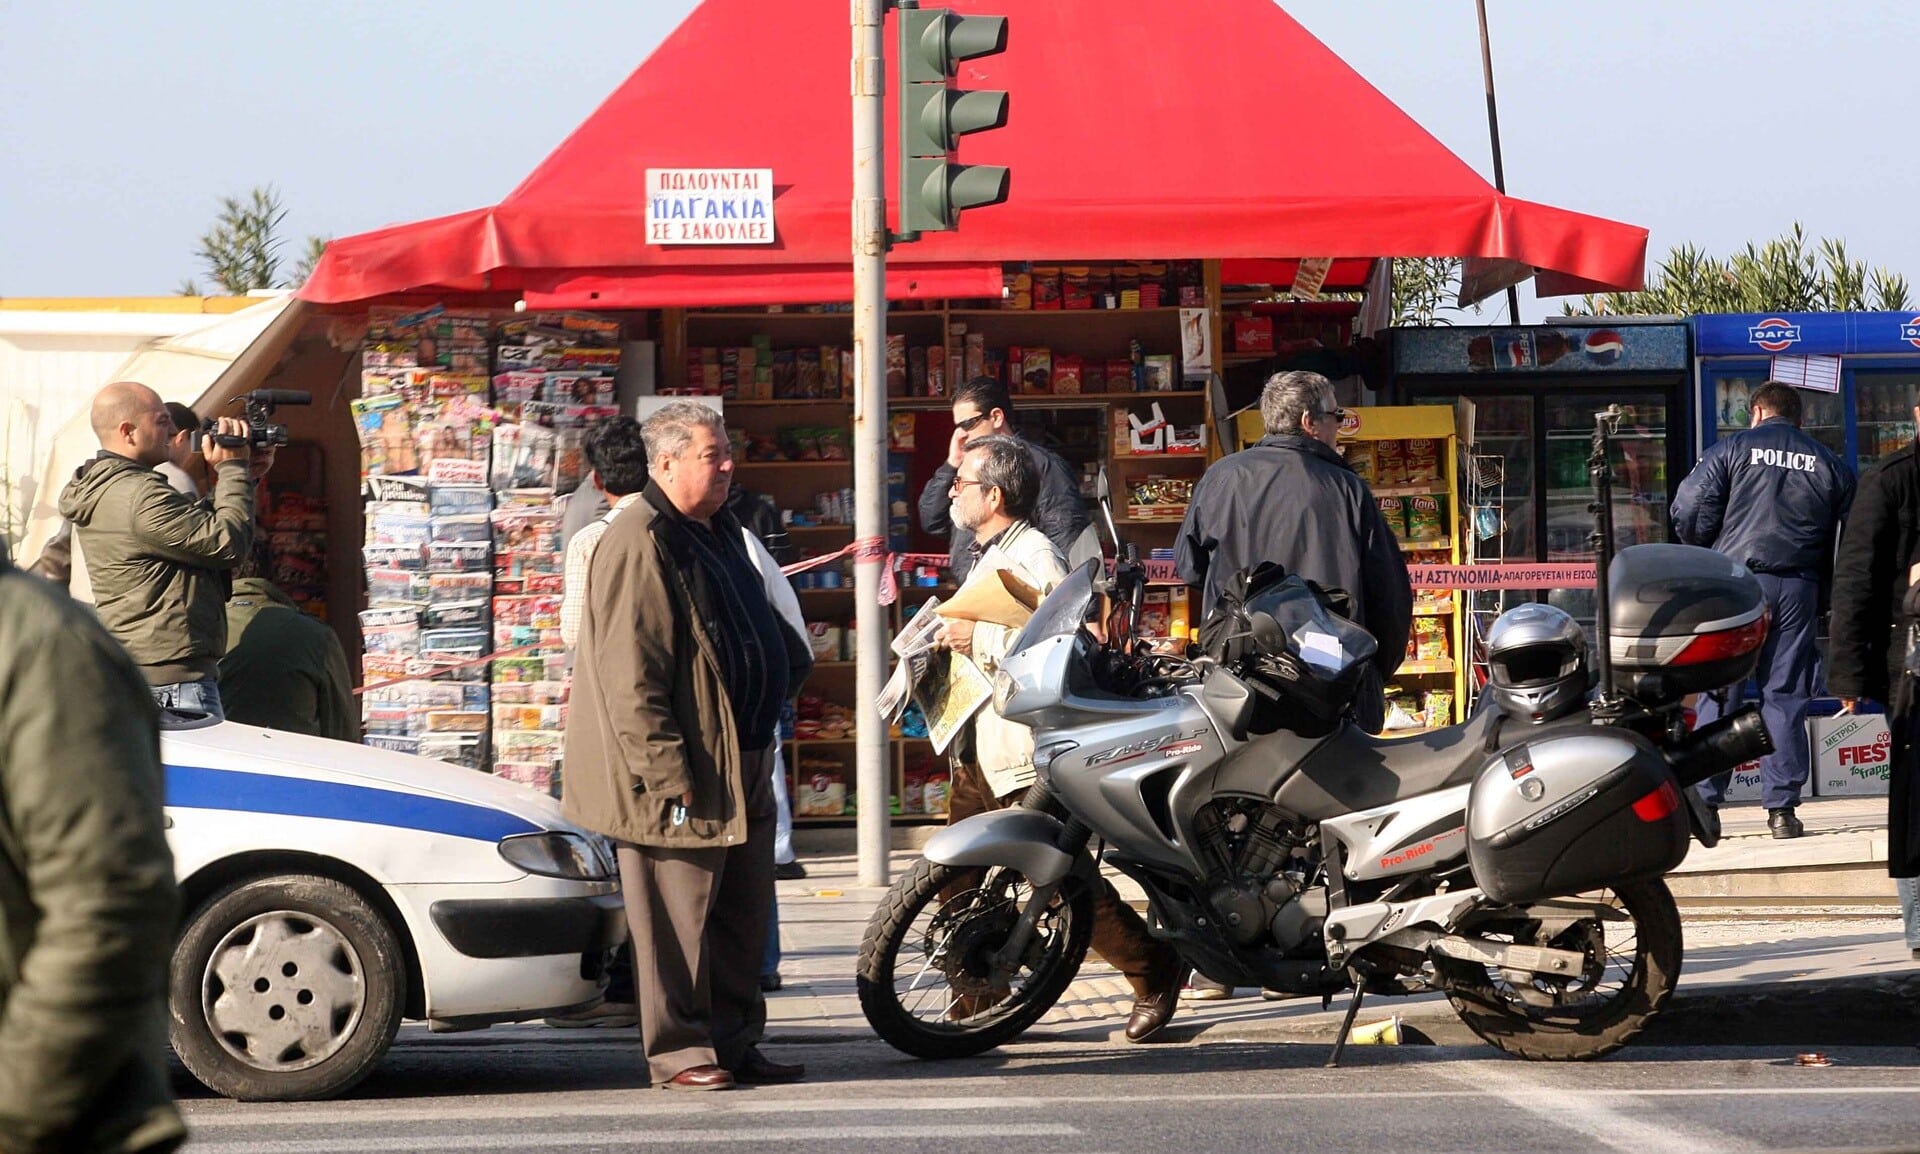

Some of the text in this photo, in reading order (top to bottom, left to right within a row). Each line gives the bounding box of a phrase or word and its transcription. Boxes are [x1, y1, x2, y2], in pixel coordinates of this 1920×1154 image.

[660, 172, 760, 190] ΠΩΛΟΥΝΤΑΙ
[653, 197, 766, 219] ΠΑΓΑΚΙΑ
[652, 222, 769, 240] ΣΕ ΣΑΚΟΥΛΕΣ
[1750, 448, 1817, 473] POLICE
[1426, 569, 1500, 585] ΑΣΤΥΝΟΜΙΑ
[1503, 570, 1565, 582] ΑΠΑΓΟΡΕΥΕΤΑΙ
[1573, 569, 1597, 580] ΕΙΣΟΔ
[1824, 721, 1859, 747] ΜΕΤΡΙΟΣ
[1164, 743, 1203, 758] Pro-Ride
[1859, 763, 1891, 779] frapp
[1380, 842, 1434, 870] Pro-Ride
